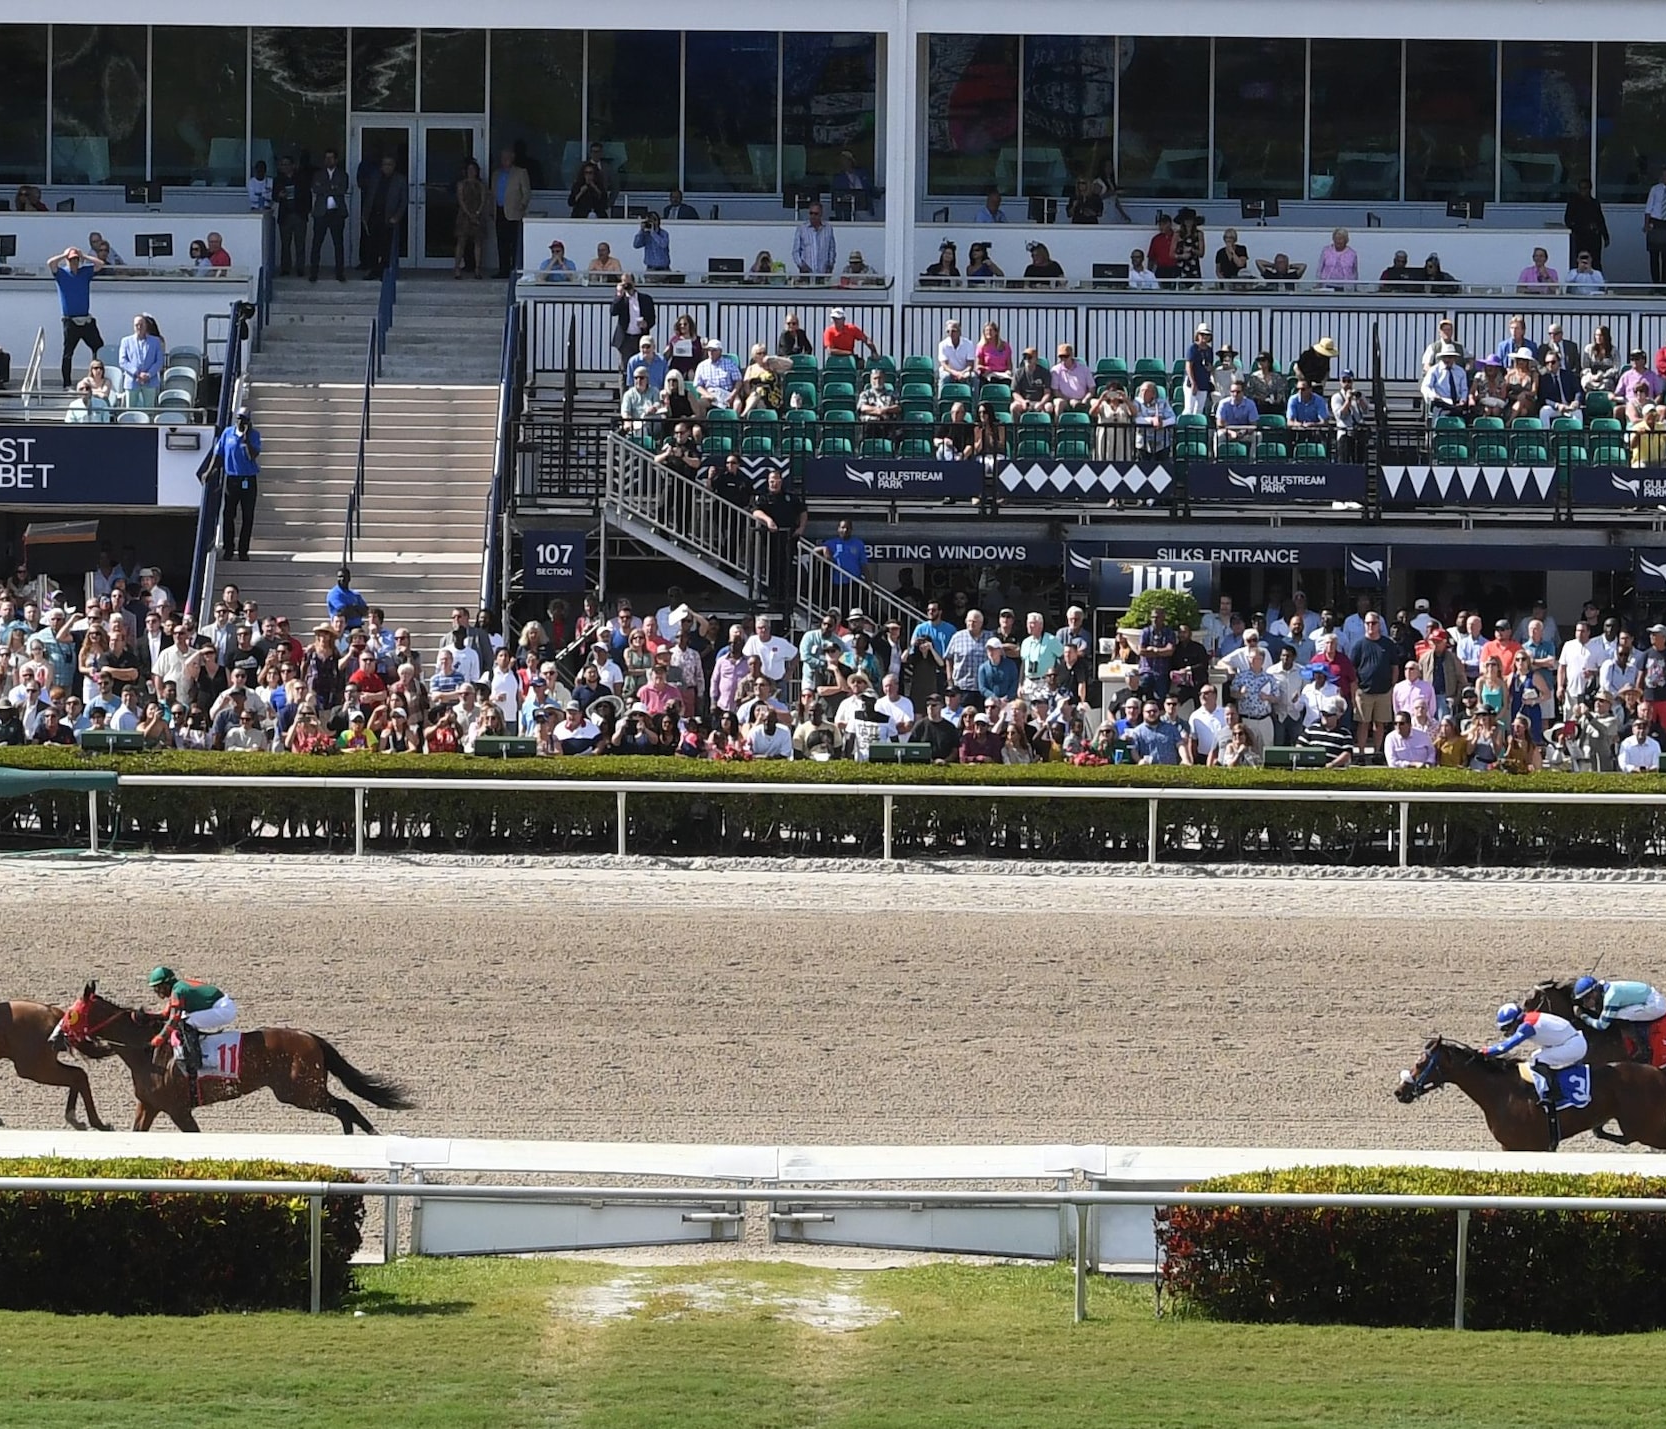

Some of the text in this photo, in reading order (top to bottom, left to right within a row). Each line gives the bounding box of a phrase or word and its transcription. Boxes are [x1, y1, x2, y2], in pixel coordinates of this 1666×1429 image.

[877, 470, 942, 481] GULFSTREAM
[1260, 475, 1325, 486] GULFSTREAM
[877, 480, 902, 489] PARK
[1260, 485, 1285, 494] PARK
[536, 543, 574, 565] 107
[865, 545, 1027, 561] BETTING WINDOWS
[1156, 548, 1300, 565] SILKS ENTRANCE
[536, 567, 573, 576] SECTION
[217, 1043, 238, 1074] 11
